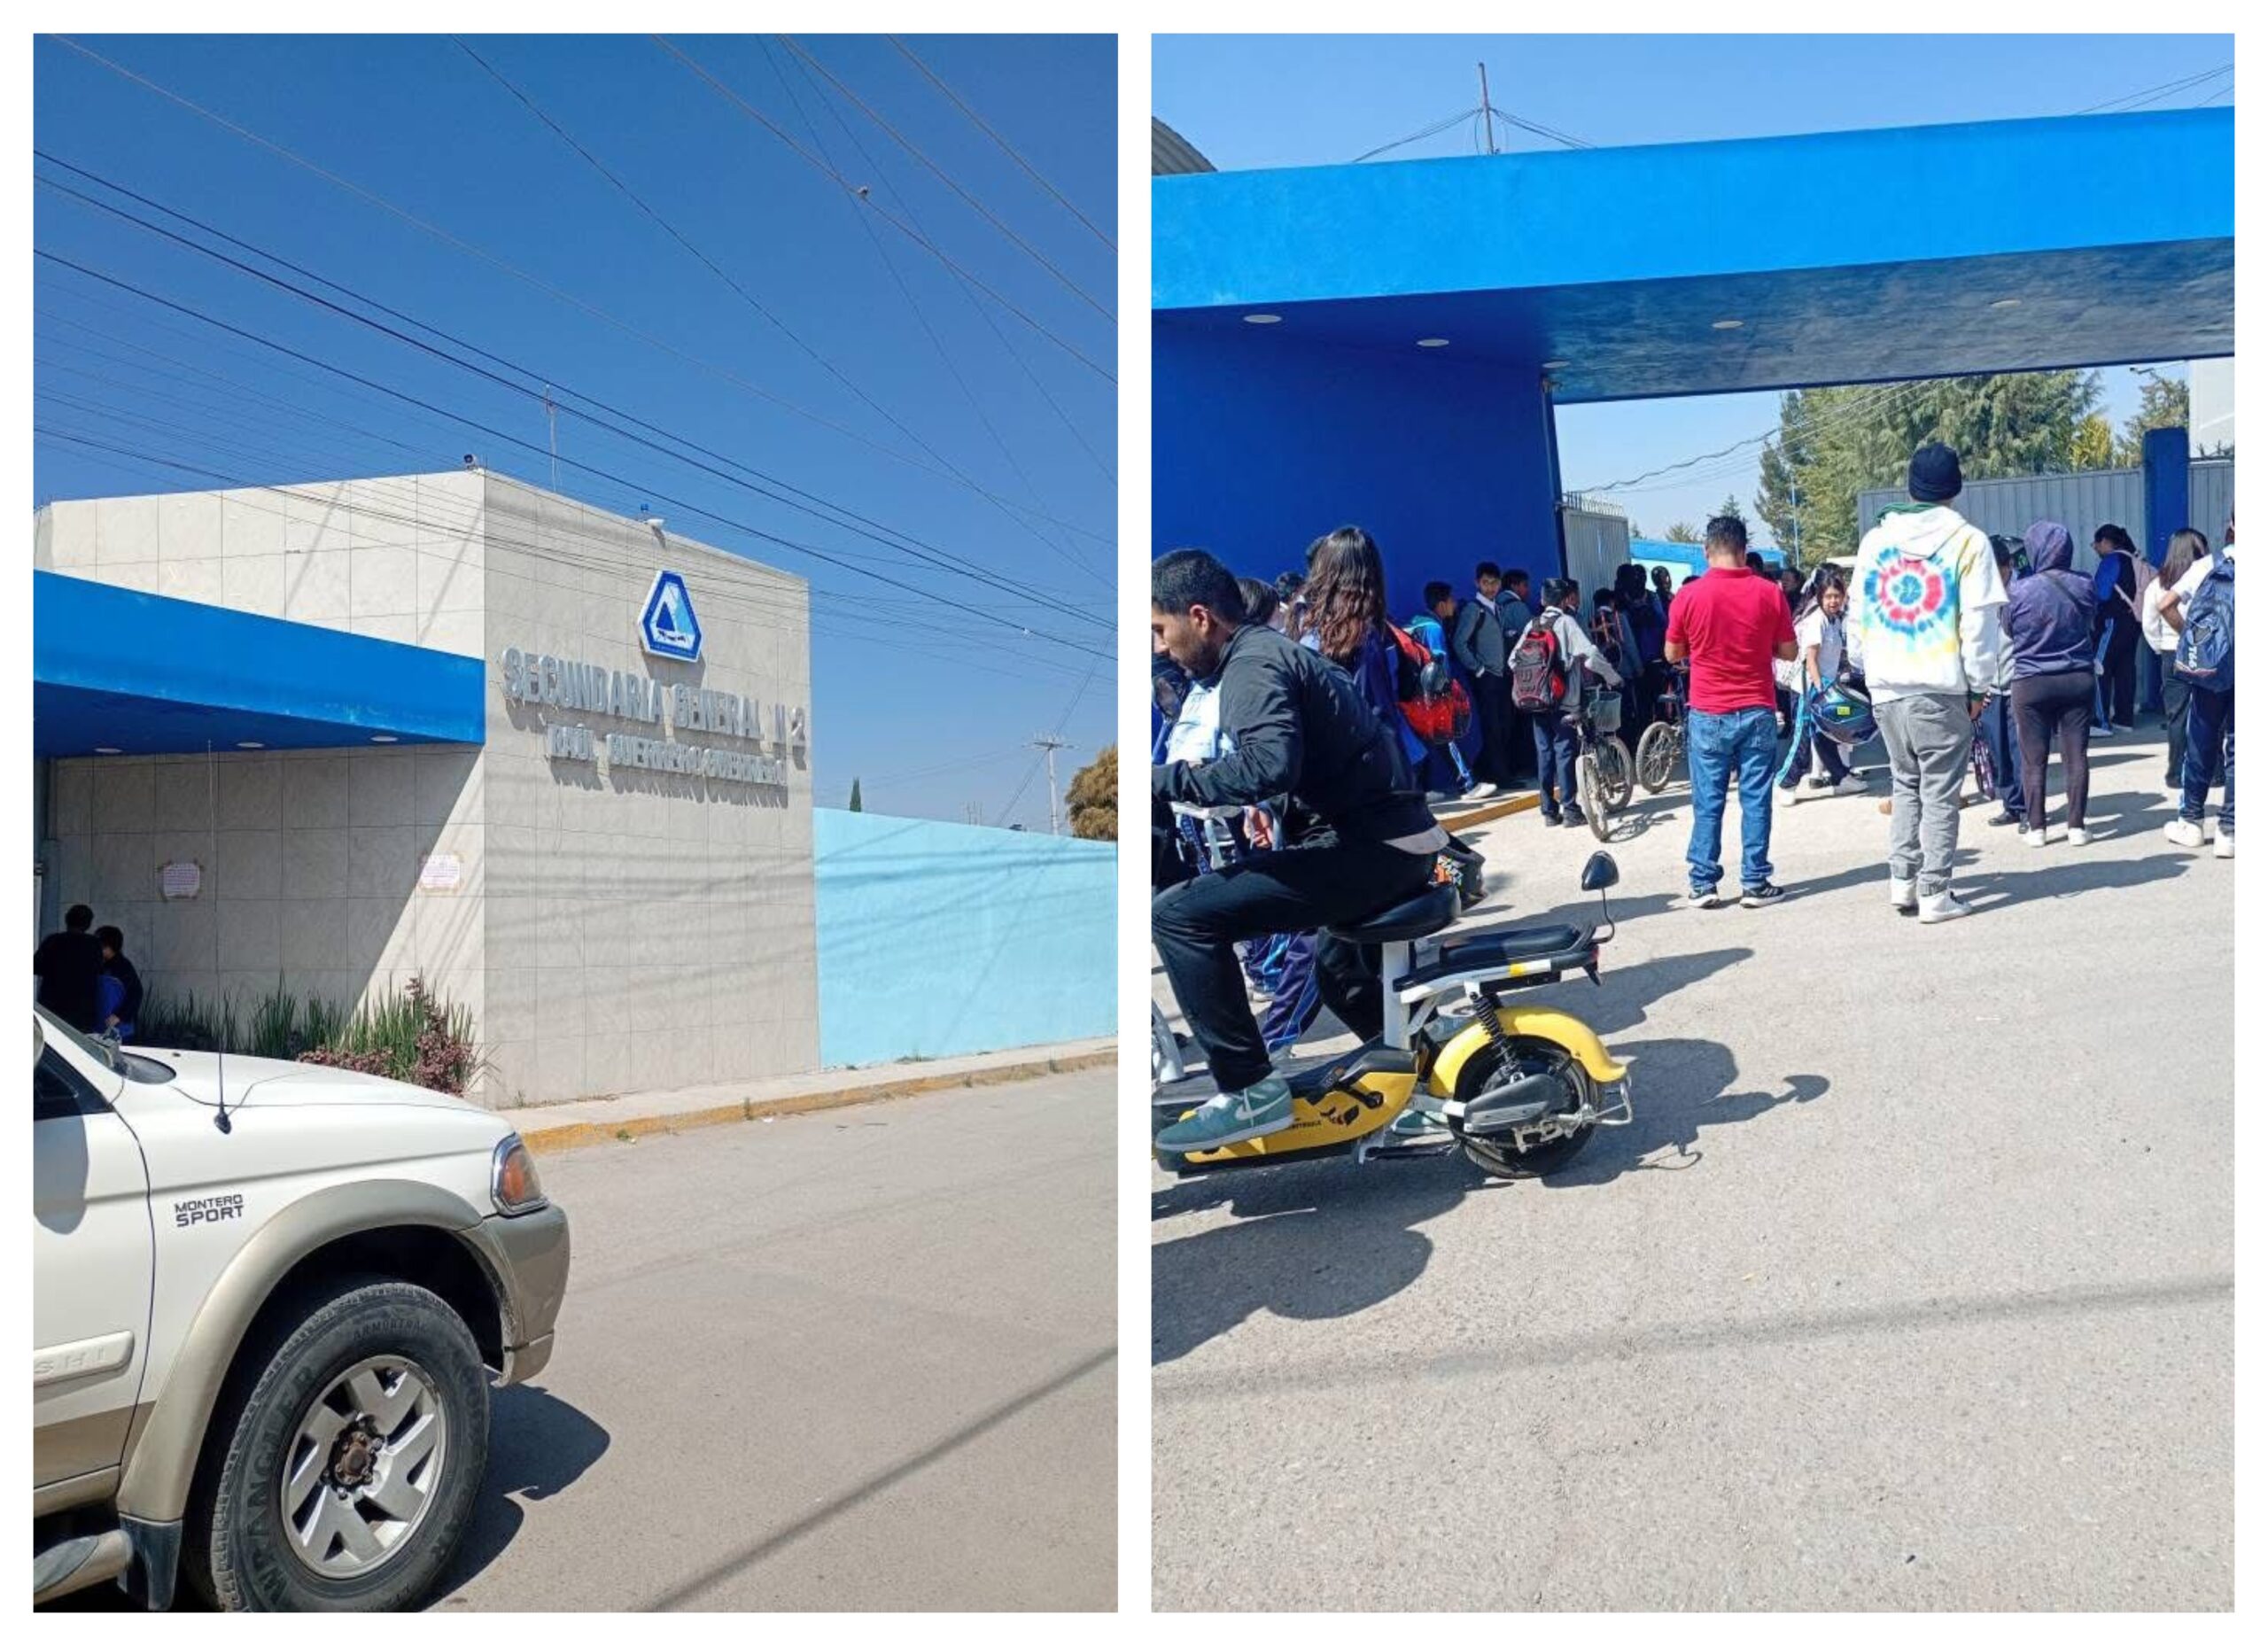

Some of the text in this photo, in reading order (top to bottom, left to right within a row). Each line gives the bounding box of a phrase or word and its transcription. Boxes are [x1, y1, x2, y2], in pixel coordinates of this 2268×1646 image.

[502, 648, 664, 724] SECUNDARIA
[672, 683, 765, 741] GENERAL
[792, 708, 805, 746] 2
[175, 1194, 243, 1213] MONTERO
[176, 1205, 244, 1227] SPORT
